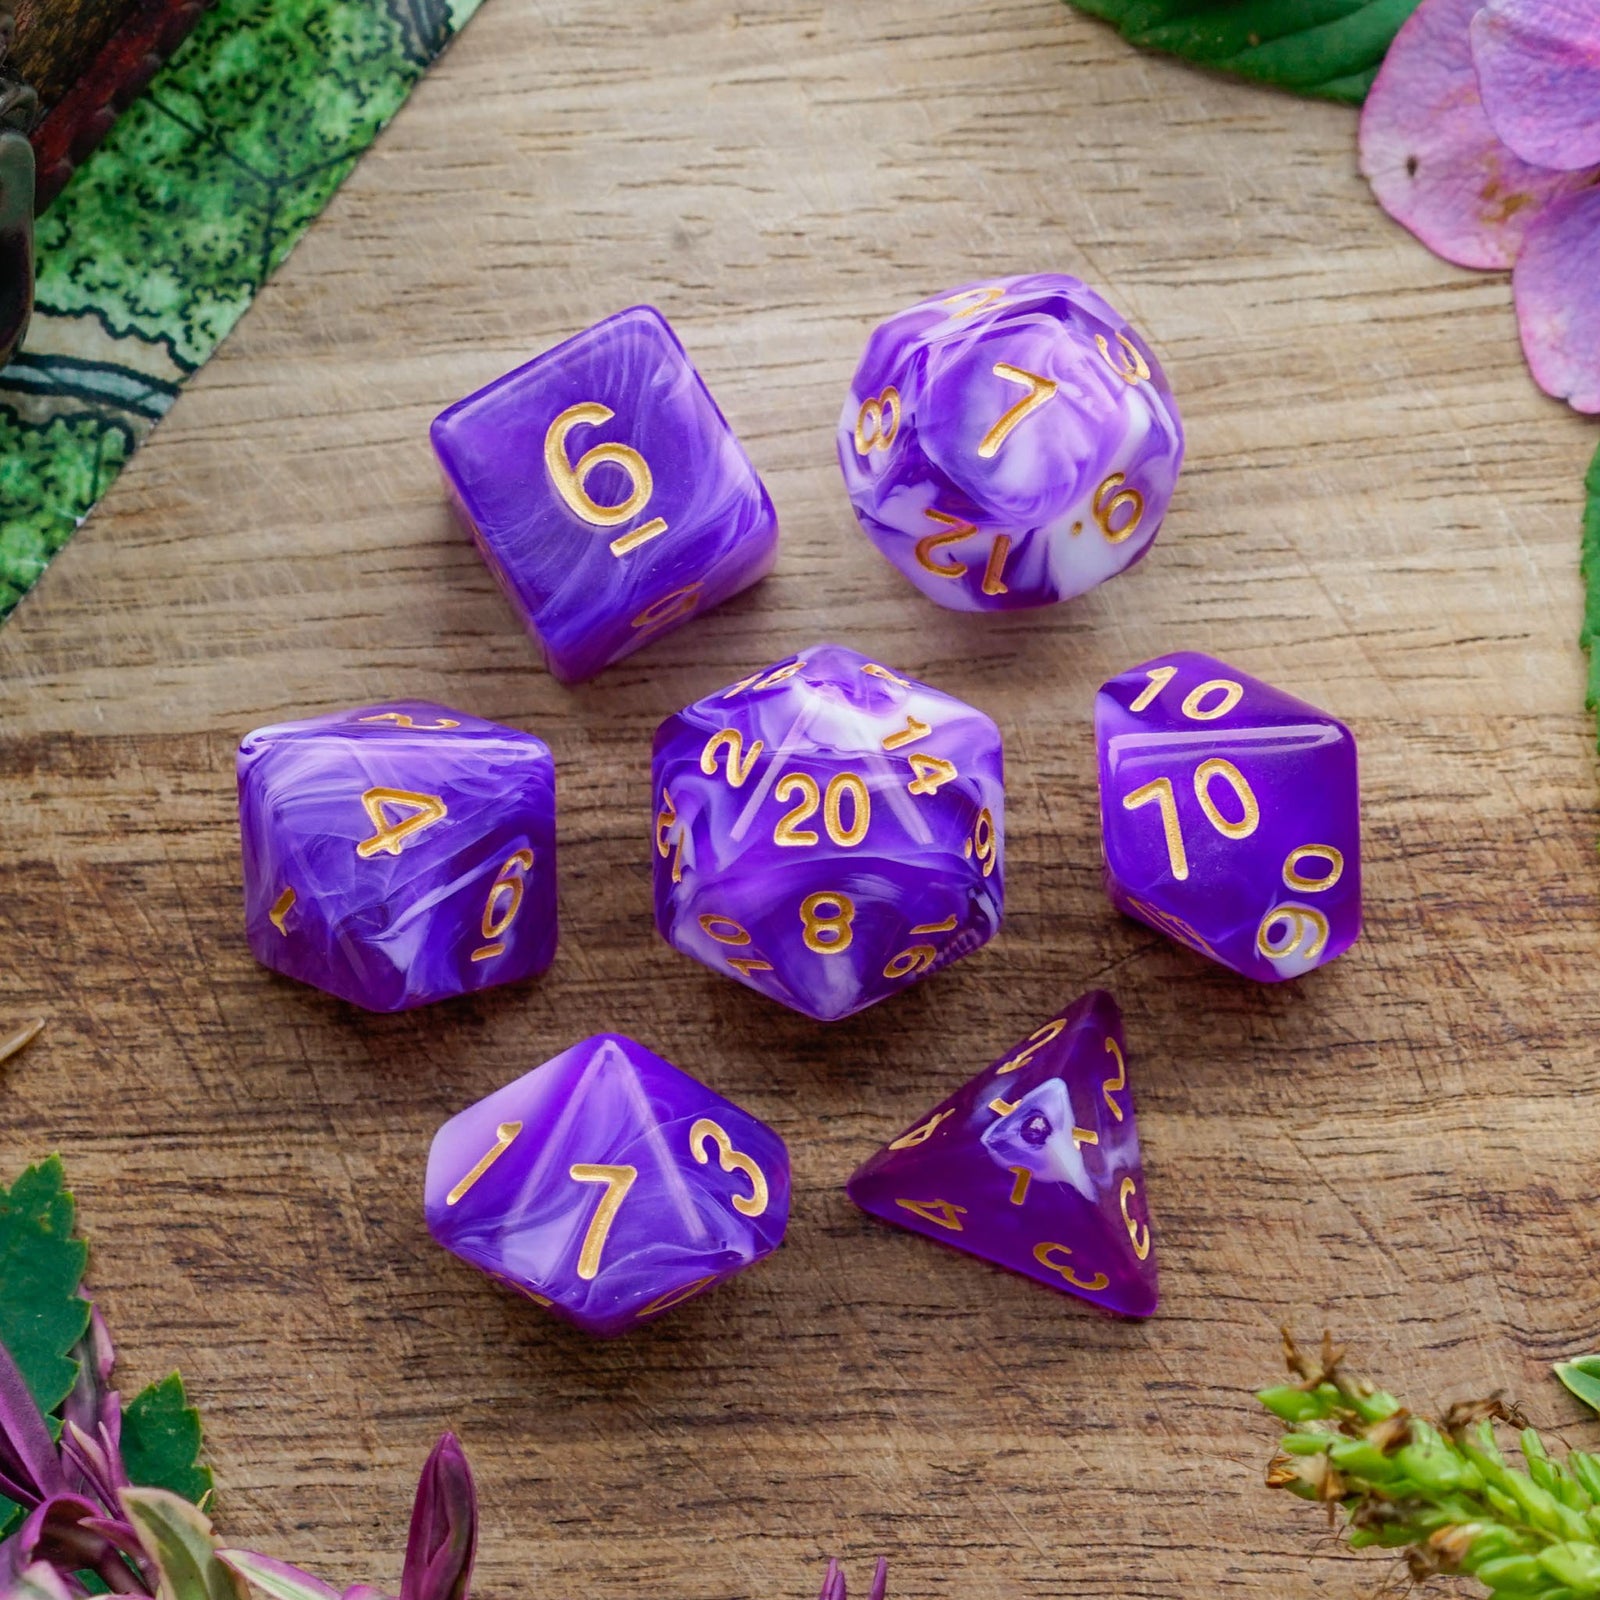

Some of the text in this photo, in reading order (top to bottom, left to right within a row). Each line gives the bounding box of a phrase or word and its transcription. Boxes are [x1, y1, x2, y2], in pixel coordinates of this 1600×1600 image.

[943, 287, 1013, 320] 2
[854, 385, 900, 456] 8
[977, 362, 1058, 458] 7
[544, 401, 669, 557] 6
[914, 508, 1012, 595] 12
[1128, 665, 1244, 720] 10
[700, 727, 764, 788] 2
[881, 715, 958, 795] 14
[356, 786, 448, 858] 4
[773, 771, 872, 847] 20
[1122, 757, 1260, 881] 70
[698, 912, 774, 977] 10
[799, 890, 856, 955] 8
[882, 913, 958, 978] 16
[1102, 1036, 1125, 1122] 2
[446, 1120, 523, 1206] 1
[688, 1117, 769, 1217] 3
[1008, 1165, 1032, 1206] 1
[568, 1163, 638, 1280] 7
[895, 1198, 968, 1232] 4
[1119, 1176, 1151, 1261] 3
[1033, 1241, 1110, 1291] 3
